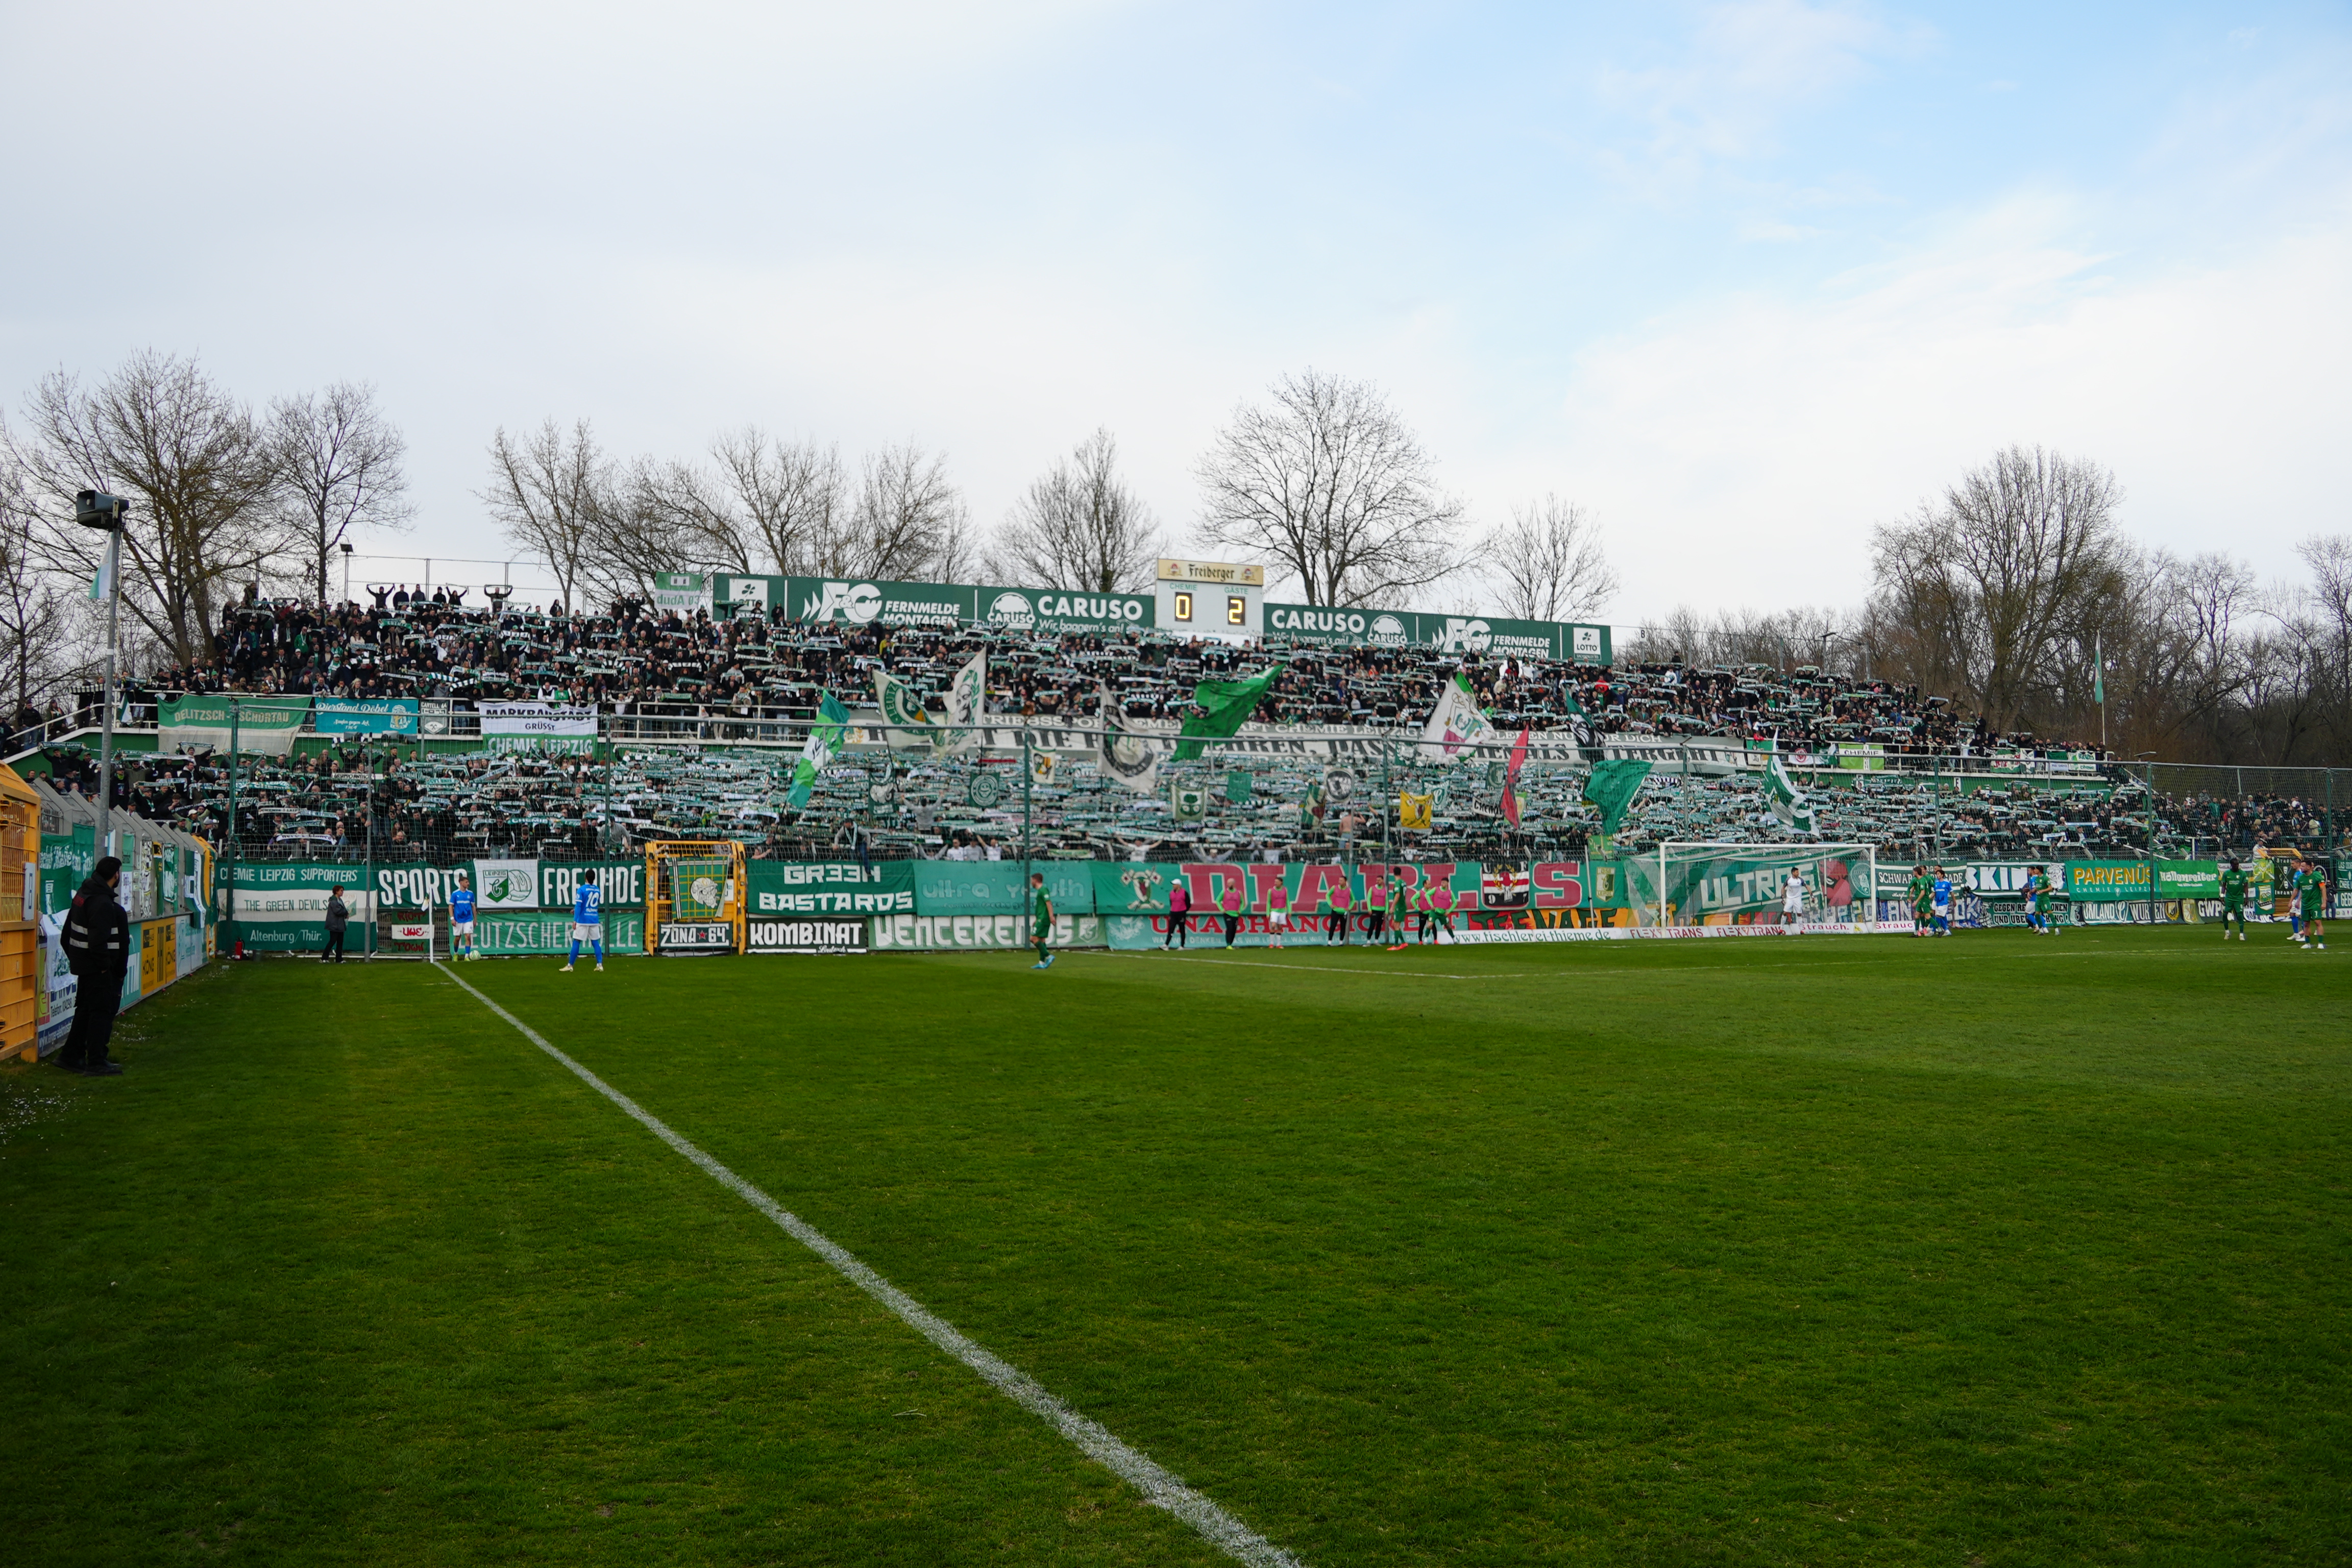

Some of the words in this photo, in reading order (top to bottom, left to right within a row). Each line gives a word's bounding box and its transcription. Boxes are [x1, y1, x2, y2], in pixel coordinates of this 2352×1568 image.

[1188, 564, 1235, 582] Freiberger
[1169, 582, 1198, 591] CHEMIE
[1224, 586, 1249, 595] GÄSTE
[885, 600, 961, 616] FERNMELDE
[1038, 595, 1143, 621] CARUSO
[1175, 595, 1190, 619] 0
[1229, 599, 1242, 623] 2
[987, 612, 1036, 624] CARUSO
[1271, 609, 1366, 634] CARUSO
[1039, 618, 1059, 630] Wir
[1108, 623, 1124, 634] an!
[1367, 633, 1407, 644] CARUSO
[1493, 634, 1551, 648] FERNMELDE
[1576, 643, 1598, 651] LOTTO
[360, 703, 389, 713] Döbel
[174, 709, 225, 722] DELITZSCH
[238, 712, 290, 723] SCHORTAU
[525, 721, 555, 731] GRÜSST
[1275, 724, 1348, 734] CHEMIE
[1629, 734, 1662, 743] DICH
[488, 737, 537, 754] CHEMIE
[544, 738, 593, 755] LEIPZIG
[219, 868, 255, 881] CEMIE
[260, 868, 296, 881] LEIPZIG
[300, 869, 358, 883] SUPPORTERS
[2159, 871, 2217, 882] Höllenreiter
[244, 900, 261, 912] THE
[266, 900, 295, 912] GREEN
[299, 899, 329, 912] DEVILS
[585, 891, 599, 908] 10
[759, 891, 913, 911] BASTARDS
[1994, 902, 2015, 912] GEGEN
[2083, 903, 2115, 920] UMLAND
[2129, 902, 2166, 920] WUREN
[1993, 915, 2010, 924] UND
[402, 927, 425, 937] UWE
[661, 927, 697, 944] ZONA
[708, 926, 726, 943] 64
[750, 923, 863, 945] KOMBINAT
[1455, 929, 1610, 943] www.tischlerei-thieme.de
